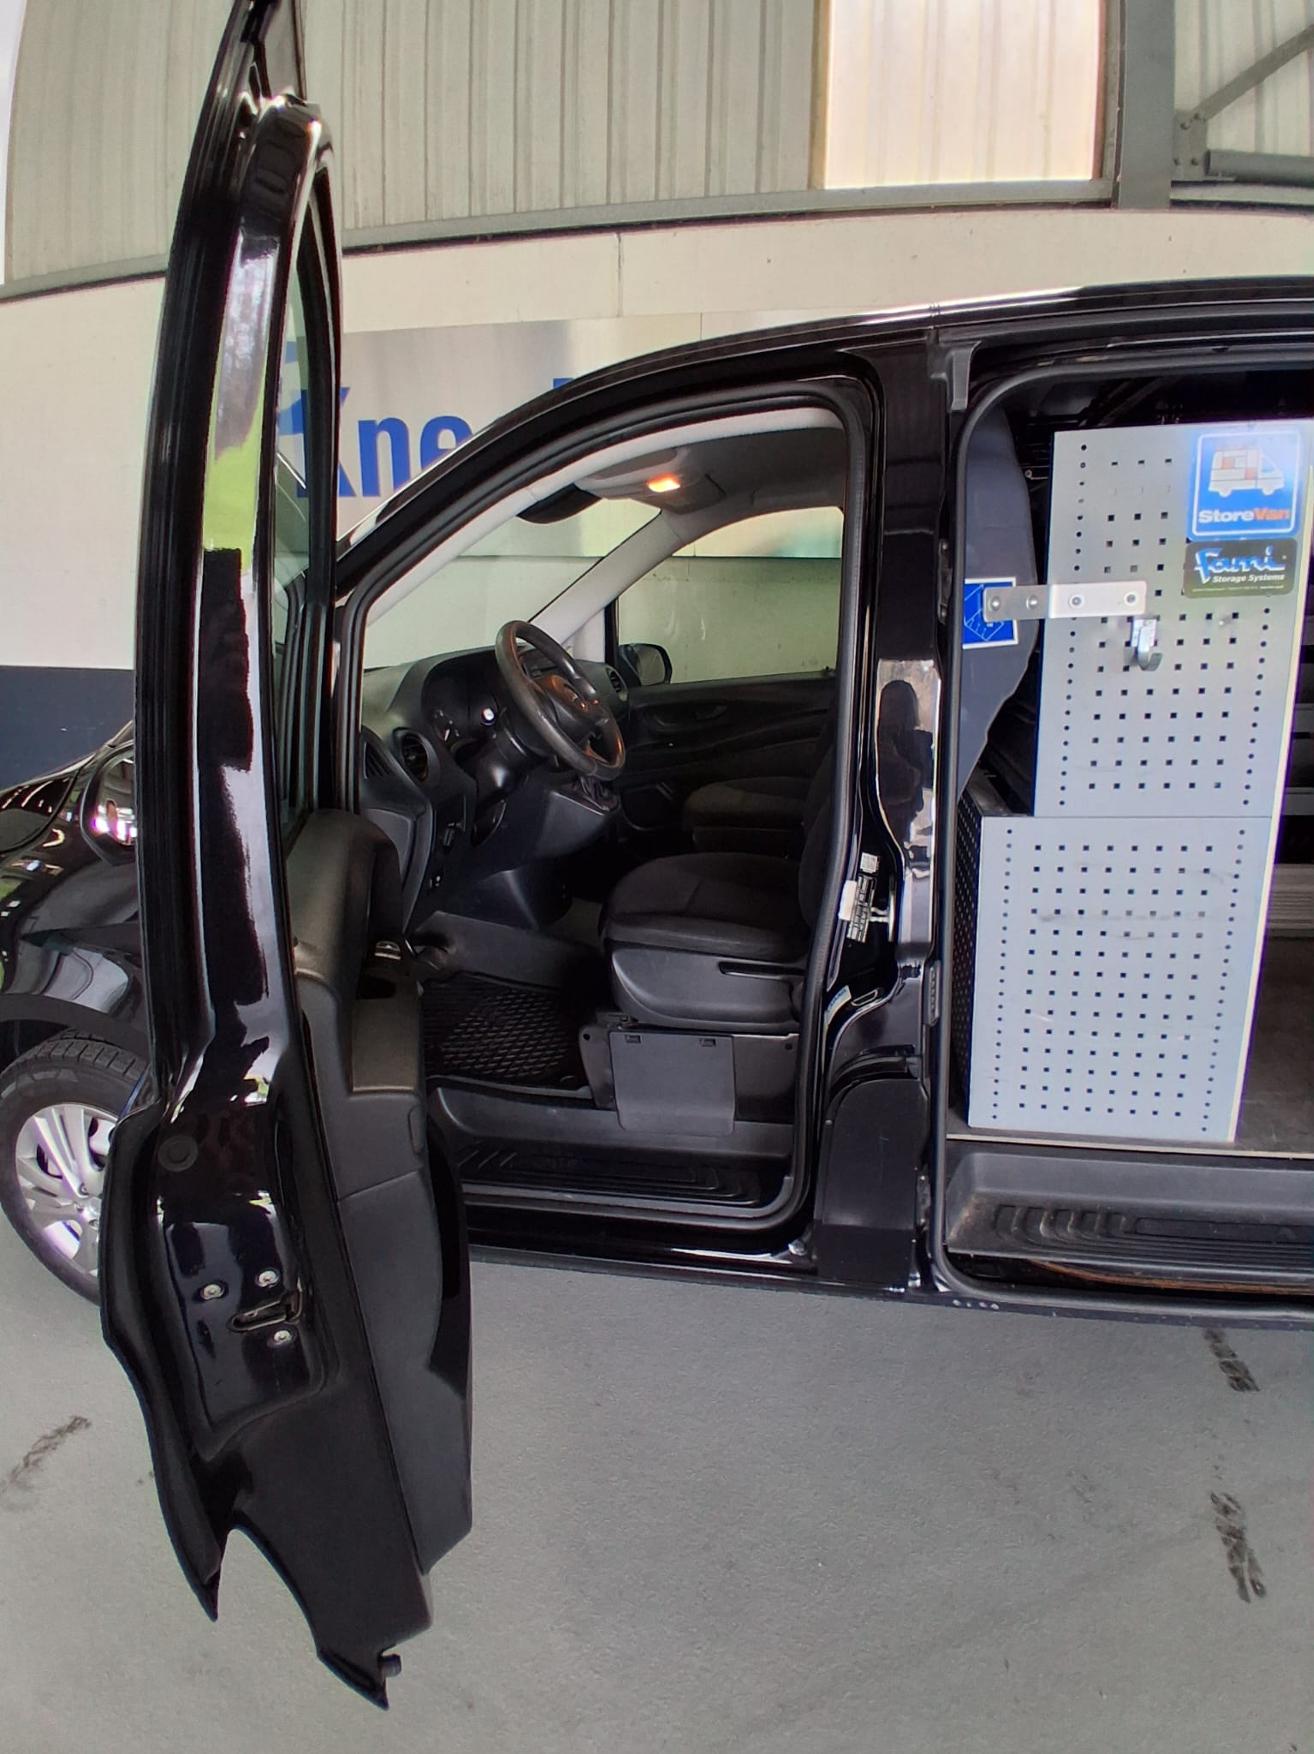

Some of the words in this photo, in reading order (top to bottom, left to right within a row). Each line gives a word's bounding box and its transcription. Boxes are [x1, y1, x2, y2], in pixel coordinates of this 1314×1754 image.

[1198, 508, 1289, 523] StoreVan
[1194, 545, 1286, 583] Fami
[1212, 574, 1246, 583] Storage
[1247, 573, 1285, 582] Systems
